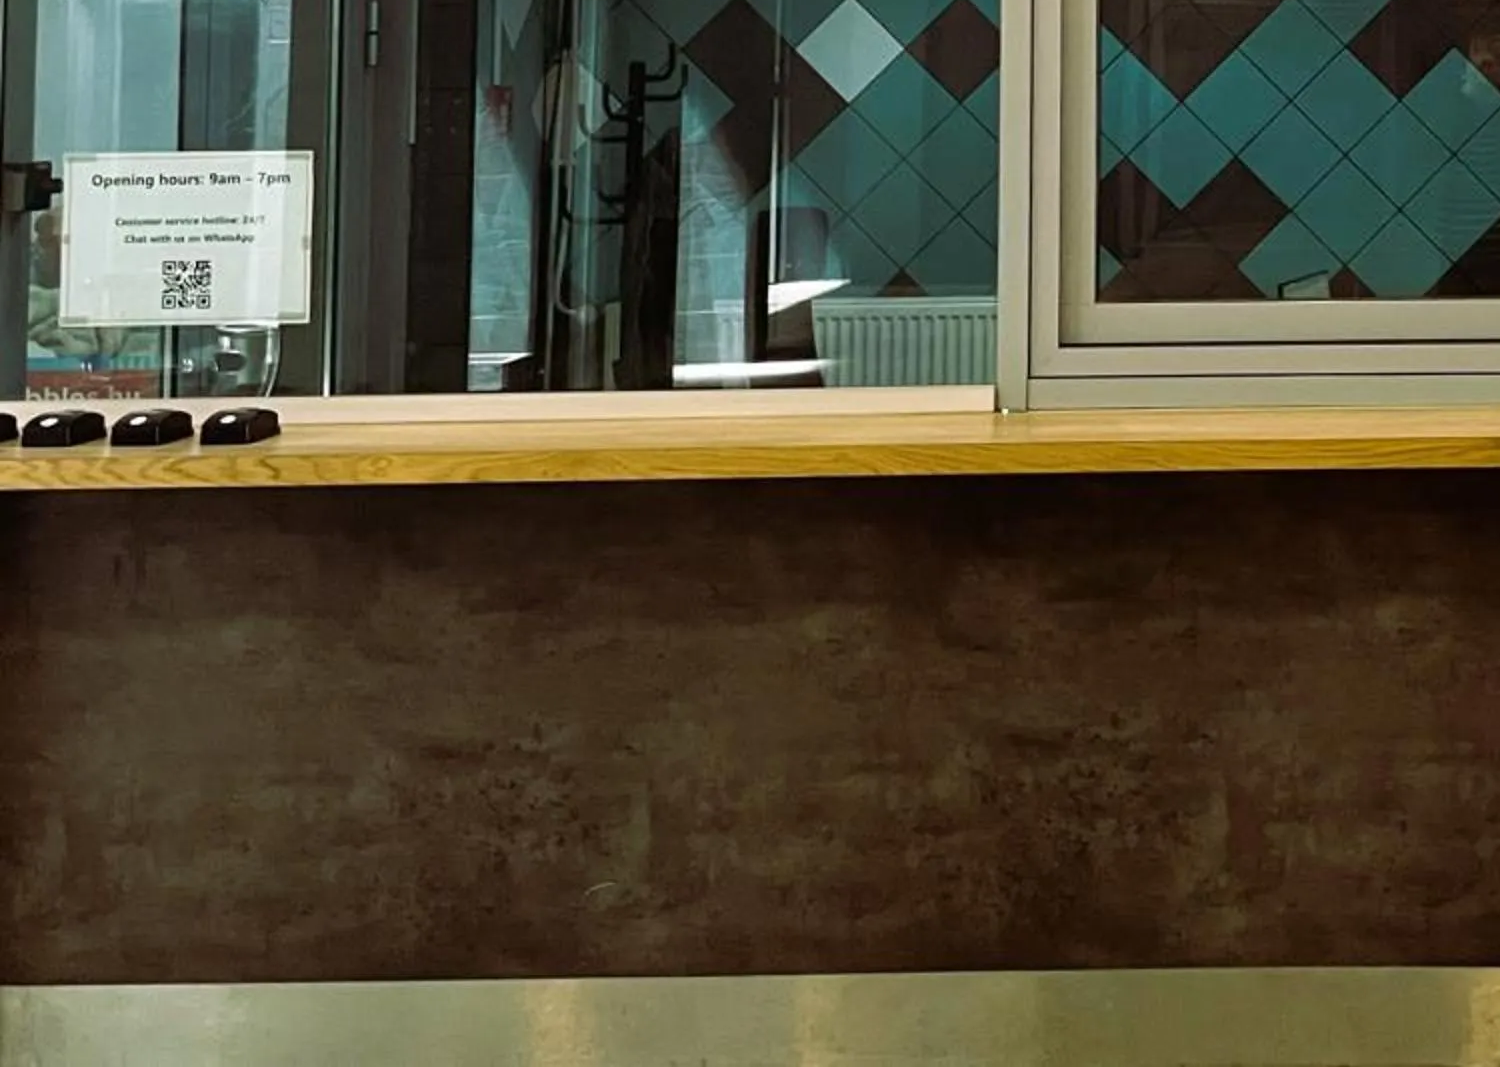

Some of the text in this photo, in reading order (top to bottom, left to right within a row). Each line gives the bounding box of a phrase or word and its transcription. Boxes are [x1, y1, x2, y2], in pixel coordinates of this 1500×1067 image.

[91, 174, 155, 190] Opening
[159, 173, 204, 186] hours:
[209, 172, 241, 185] 9am
[257, 172, 291, 186] 7pm
[165, 218, 199, 226] service
[124, 234, 147, 243] Chat
[150, 235, 171, 243] with
[203, 233, 255, 244] WhatsApp
